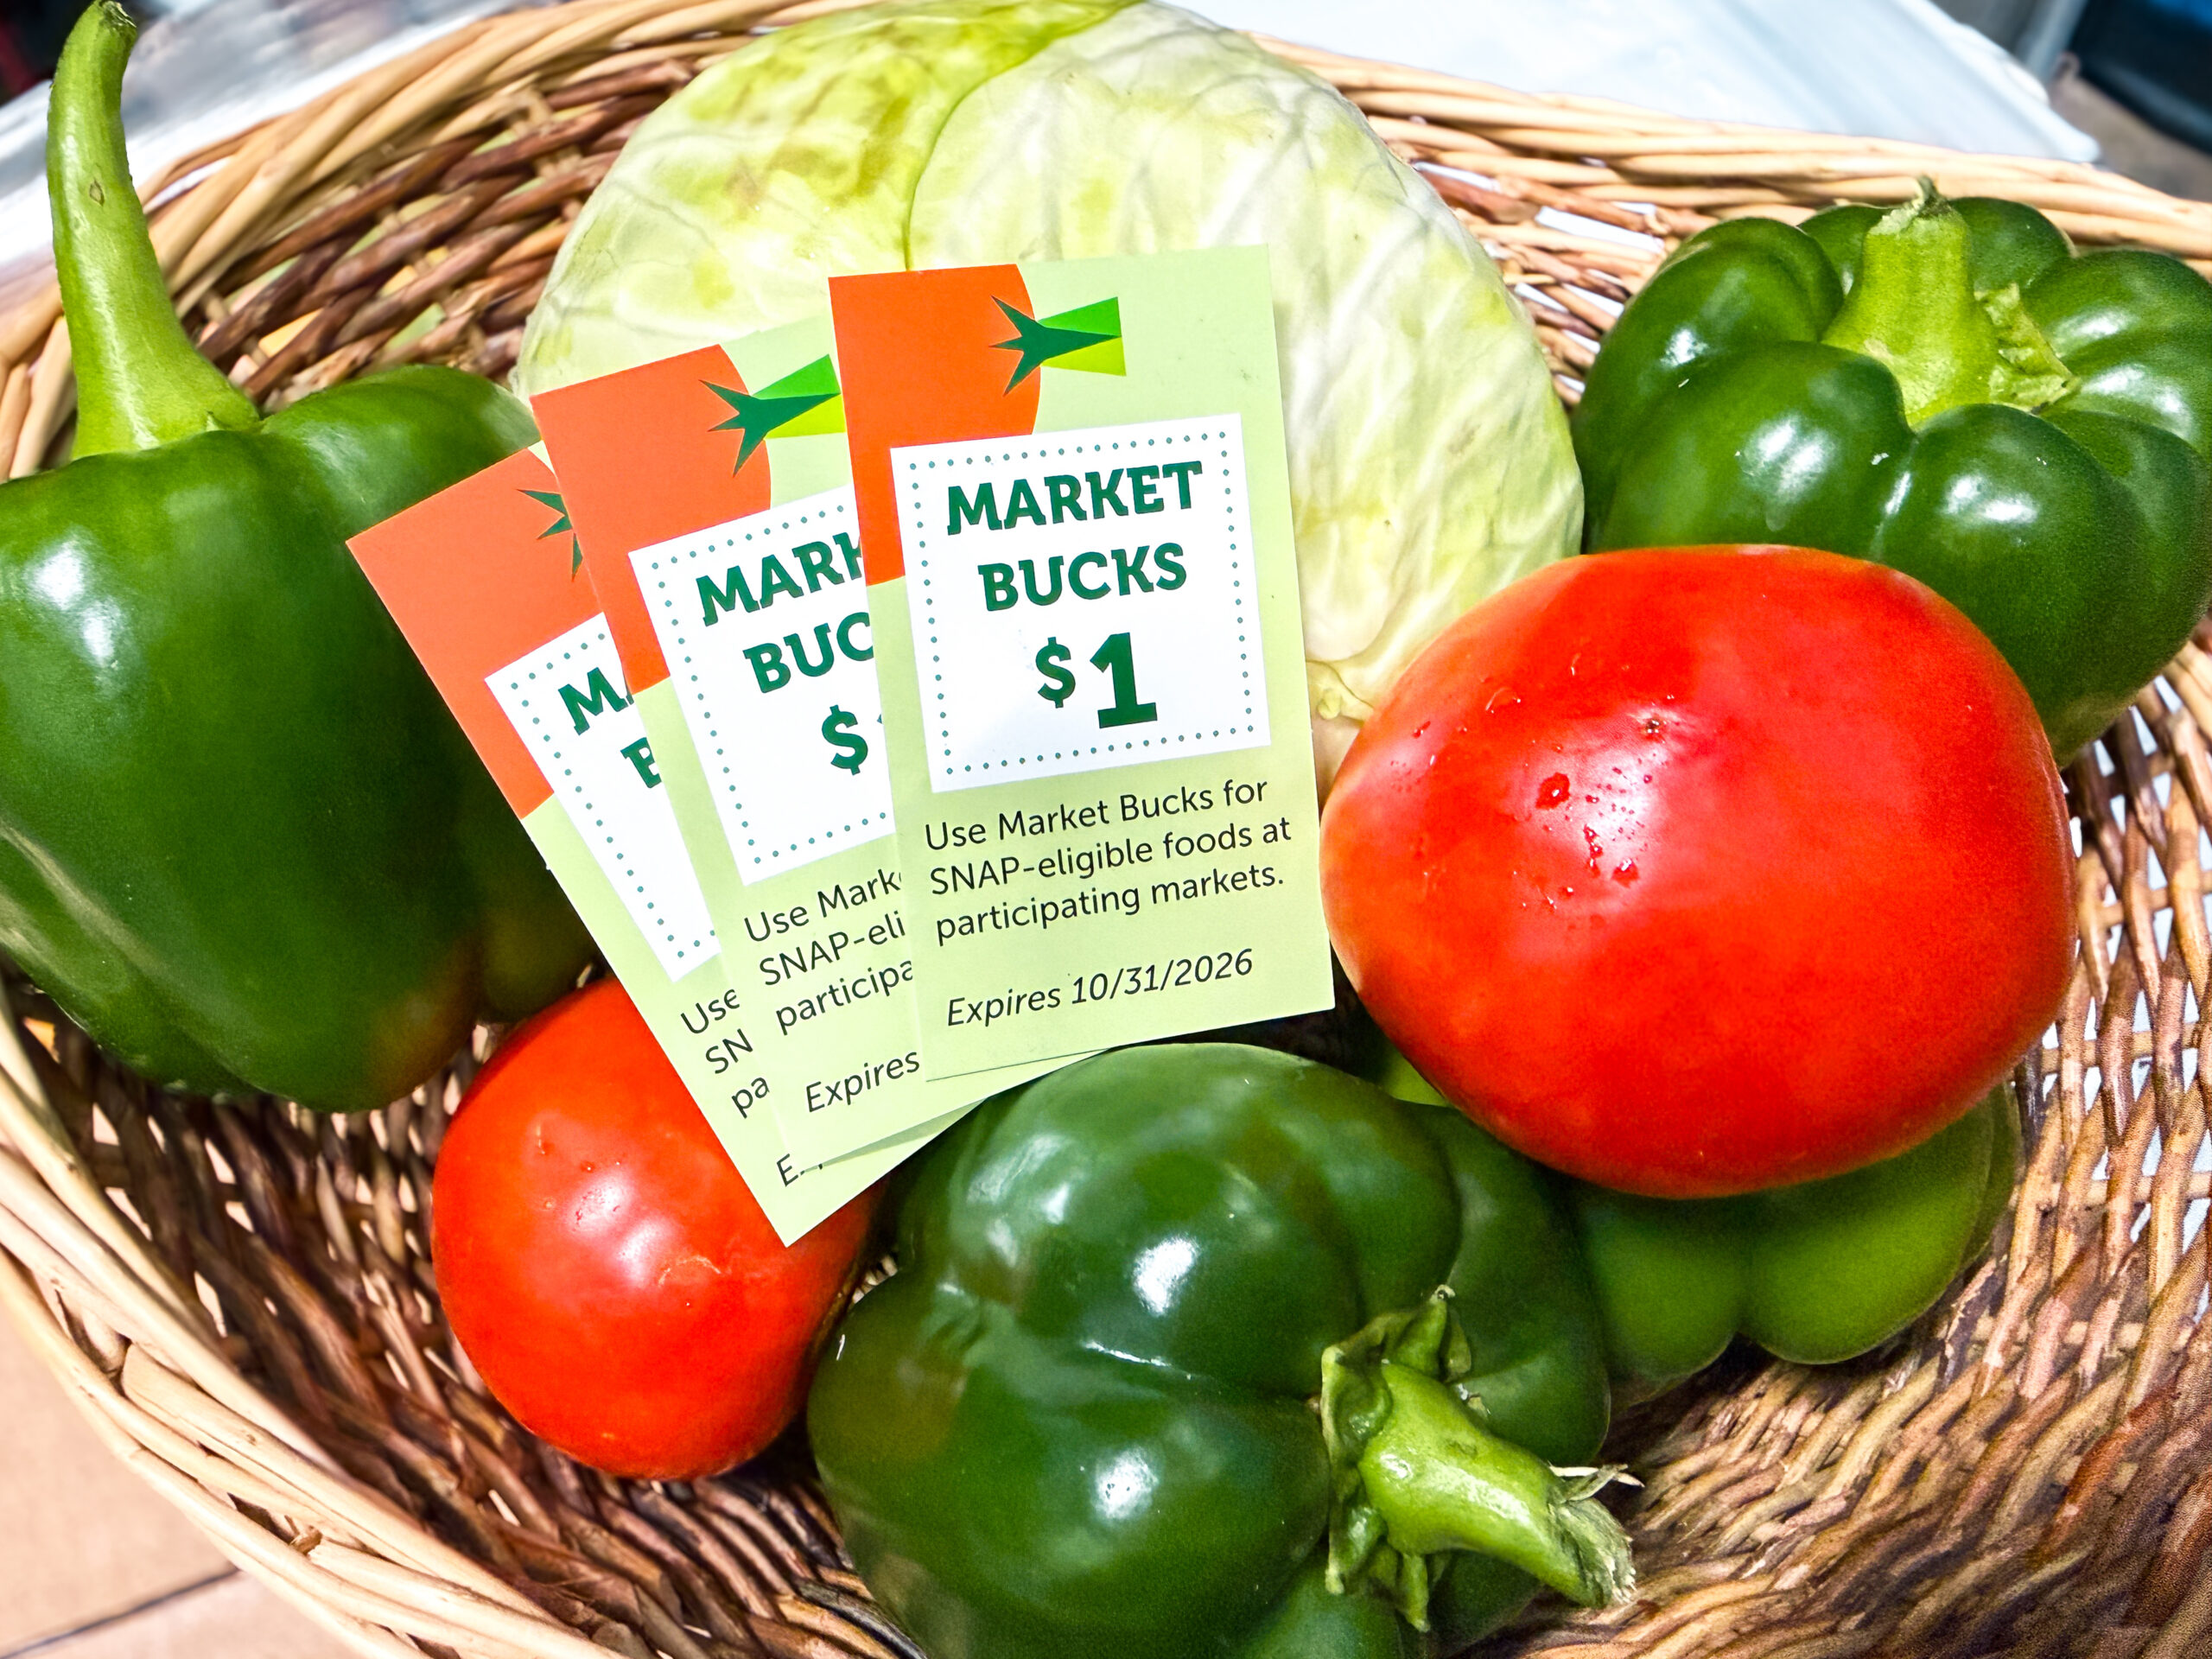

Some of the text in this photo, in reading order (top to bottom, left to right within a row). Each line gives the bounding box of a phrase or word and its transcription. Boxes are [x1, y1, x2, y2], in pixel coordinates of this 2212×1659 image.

[947, 461, 1203, 536] MARKET
[977, 542, 1187, 612] BUCKS
[1035, 632, 1158, 729] $1
[925, 779, 1268, 850] Use Market Bucks for
[930, 817, 1292, 896] SNAP-eligible foods at
[744, 868, 901, 942] Use Mark
[937, 864, 1283, 947] participating markets.
[760, 910, 906, 986] SNAP-eli
[680, 988, 741, 1034] Use
[774, 960, 913, 1036] participa
[948, 948, 1253, 1027] Expires 10/31/2026
[705, 1028, 753, 1074] SN
[806, 1052, 920, 1113] Expires
[731, 1077, 770, 1119] pa
